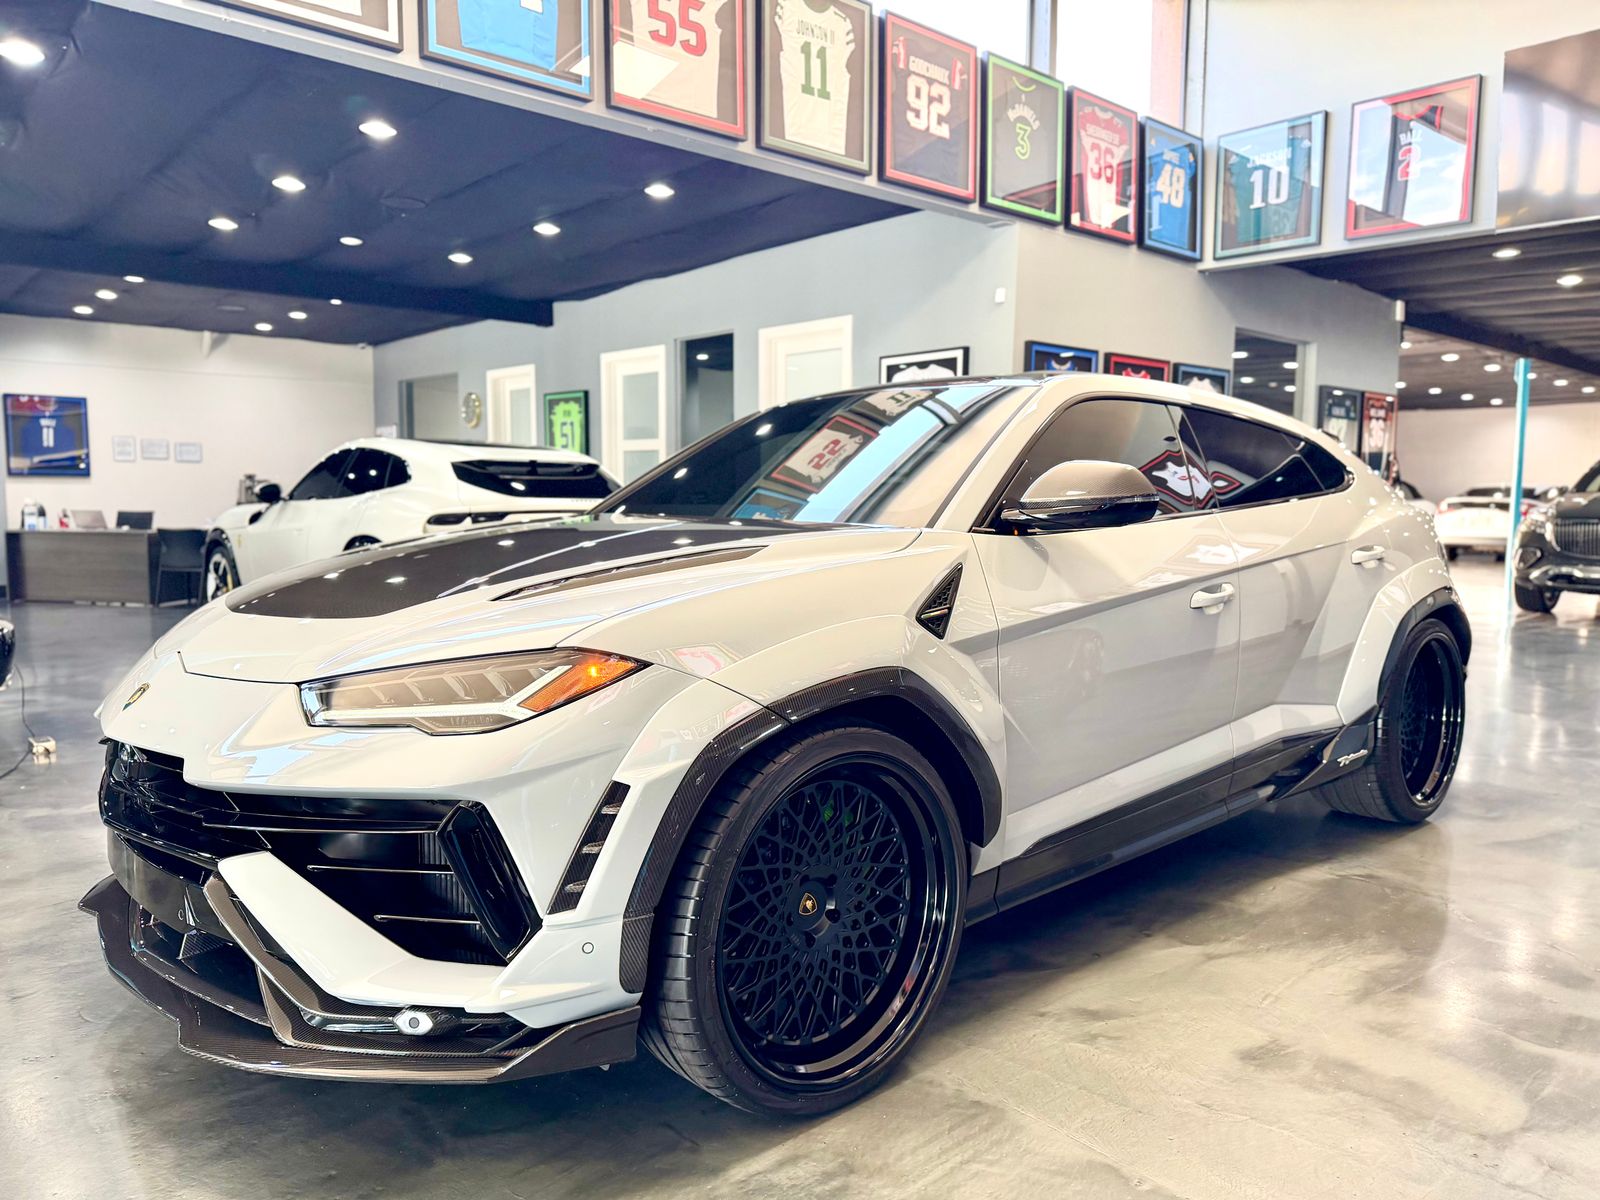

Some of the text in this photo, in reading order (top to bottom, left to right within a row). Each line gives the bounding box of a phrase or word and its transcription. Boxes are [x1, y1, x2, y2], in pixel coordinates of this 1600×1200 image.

[647, 0, 707, 57] 55
[796, 17, 828, 43] JOHNSON
[800, 40, 831, 101] 11
[906, 73, 952, 140] 92
[1014, 122, 1032, 160] 3
[1089, 141, 1115, 185] 36
[1397, 142, 1422, 181] 2
[1156, 163, 1186, 209] 48
[1249, 166, 1291, 210] 10
[560, 421, 576, 449] 51
